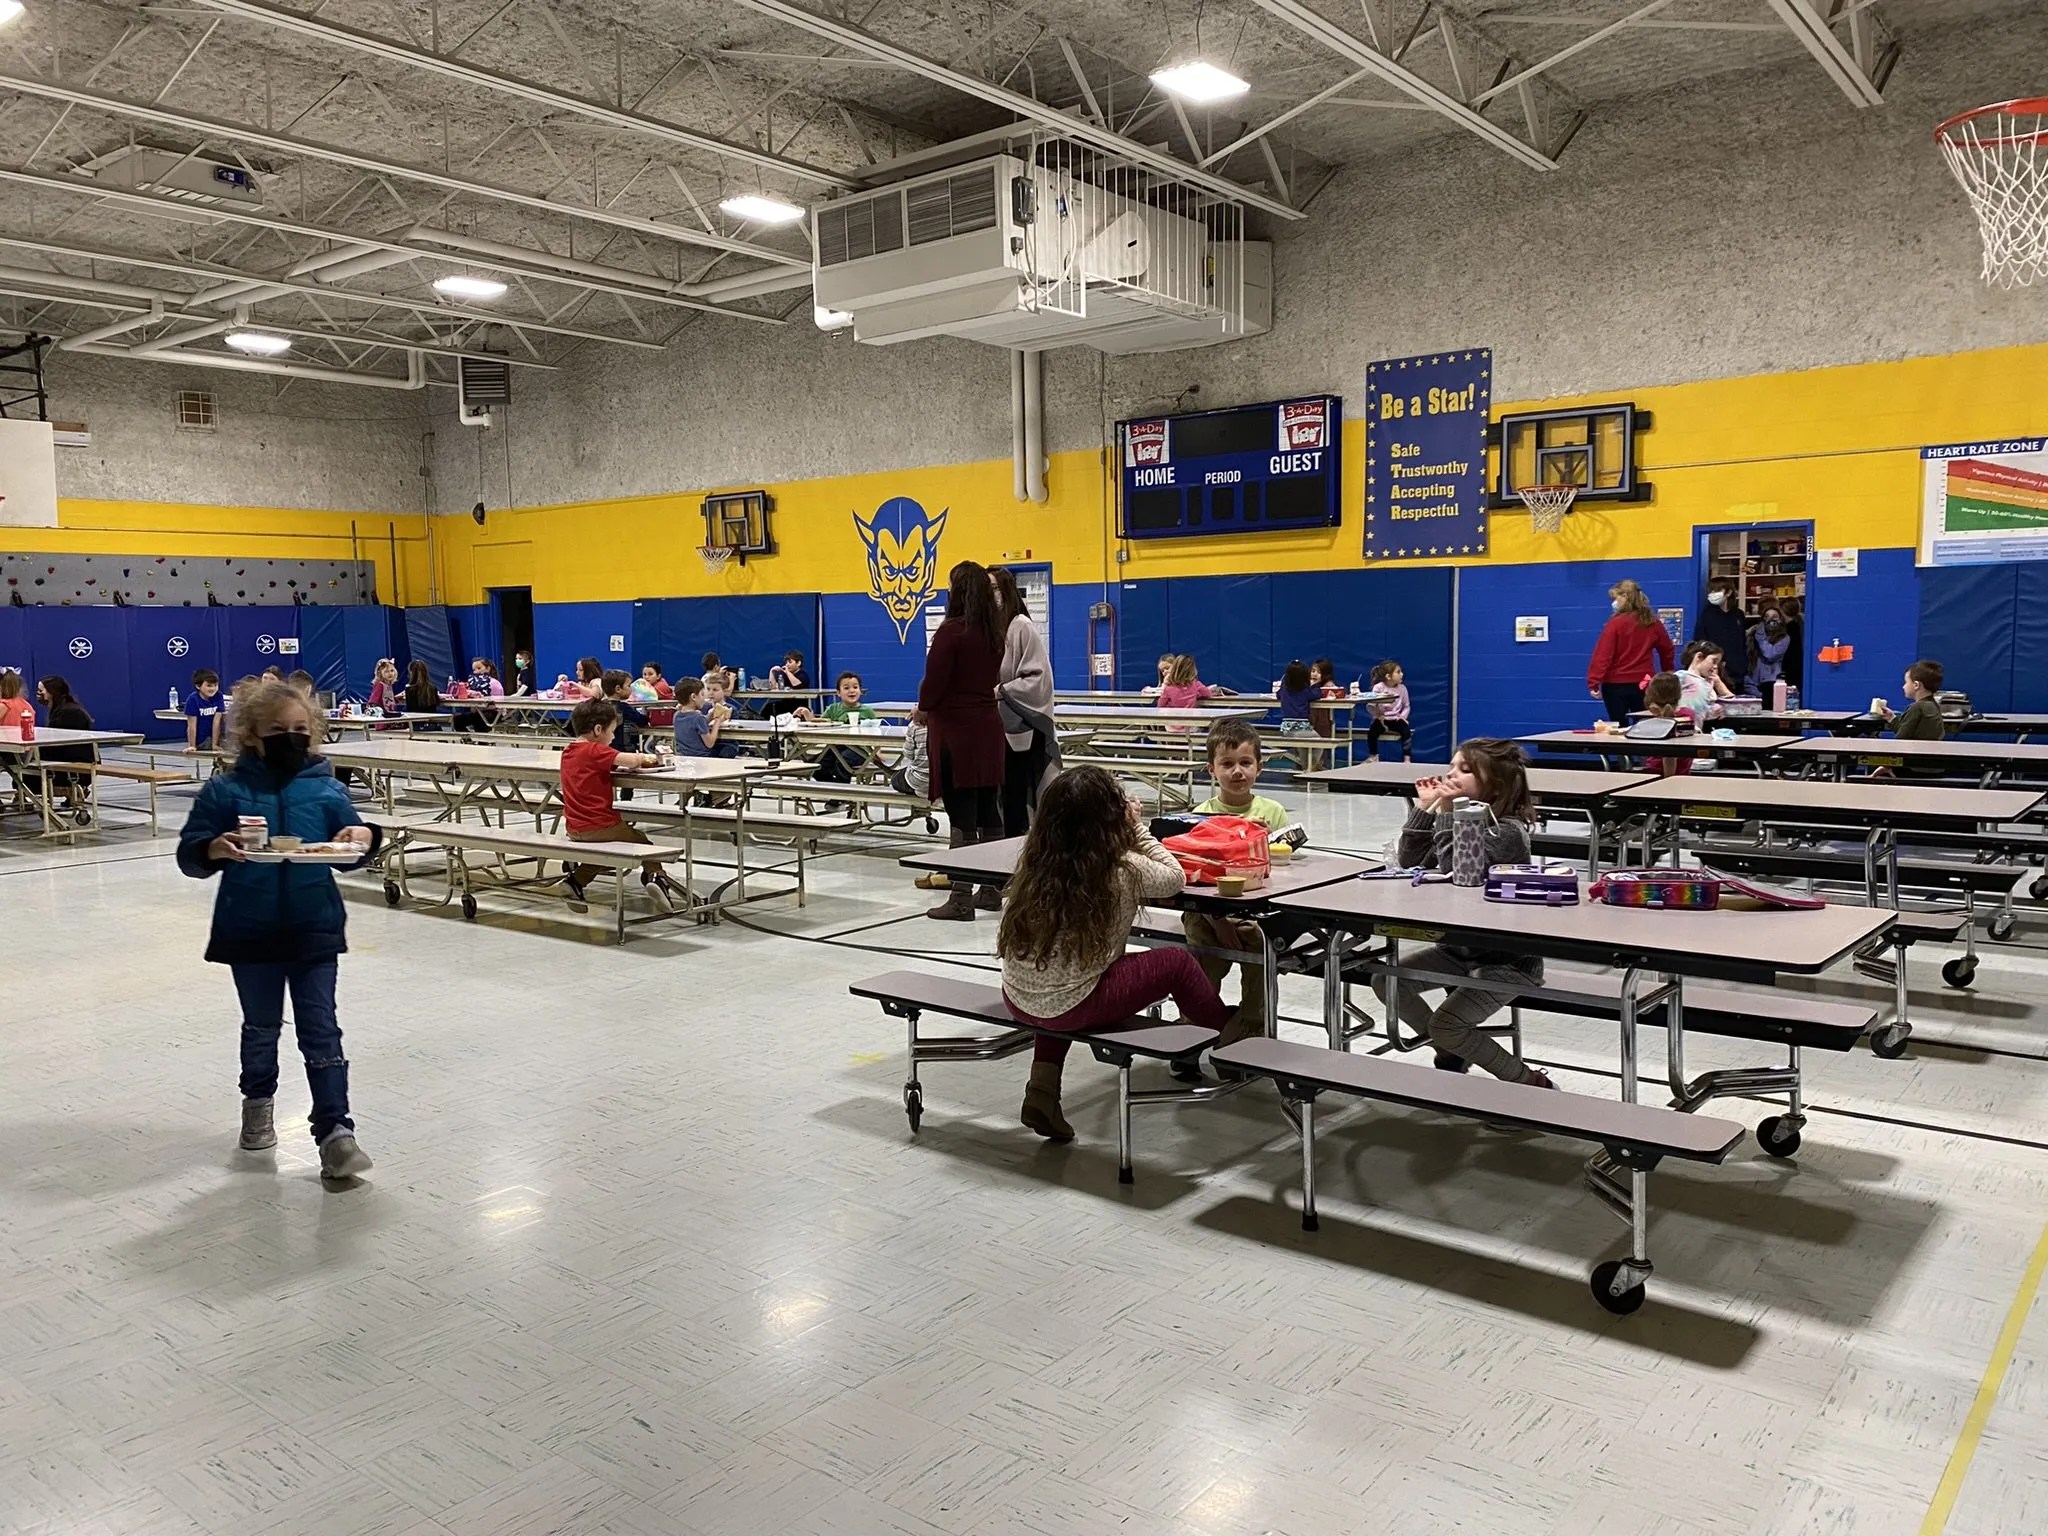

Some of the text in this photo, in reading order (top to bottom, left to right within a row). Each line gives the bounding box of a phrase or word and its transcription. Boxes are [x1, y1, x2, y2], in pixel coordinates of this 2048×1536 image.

[1380, 383, 1475, 420] Be a Star!
[1391, 443, 1421, 458] Safe
[1927, 441, 2039, 458] HEART RATE ZONE
[1270, 452, 1322, 474] GUEST
[1391, 461, 1468, 479] Trustworthy
[1135, 467, 1175, 487] HOME
[1205, 470, 1241, 485] PERIOD
[1391, 483, 1456, 500] Accepting
[1391, 503, 1460, 521] Respectful
